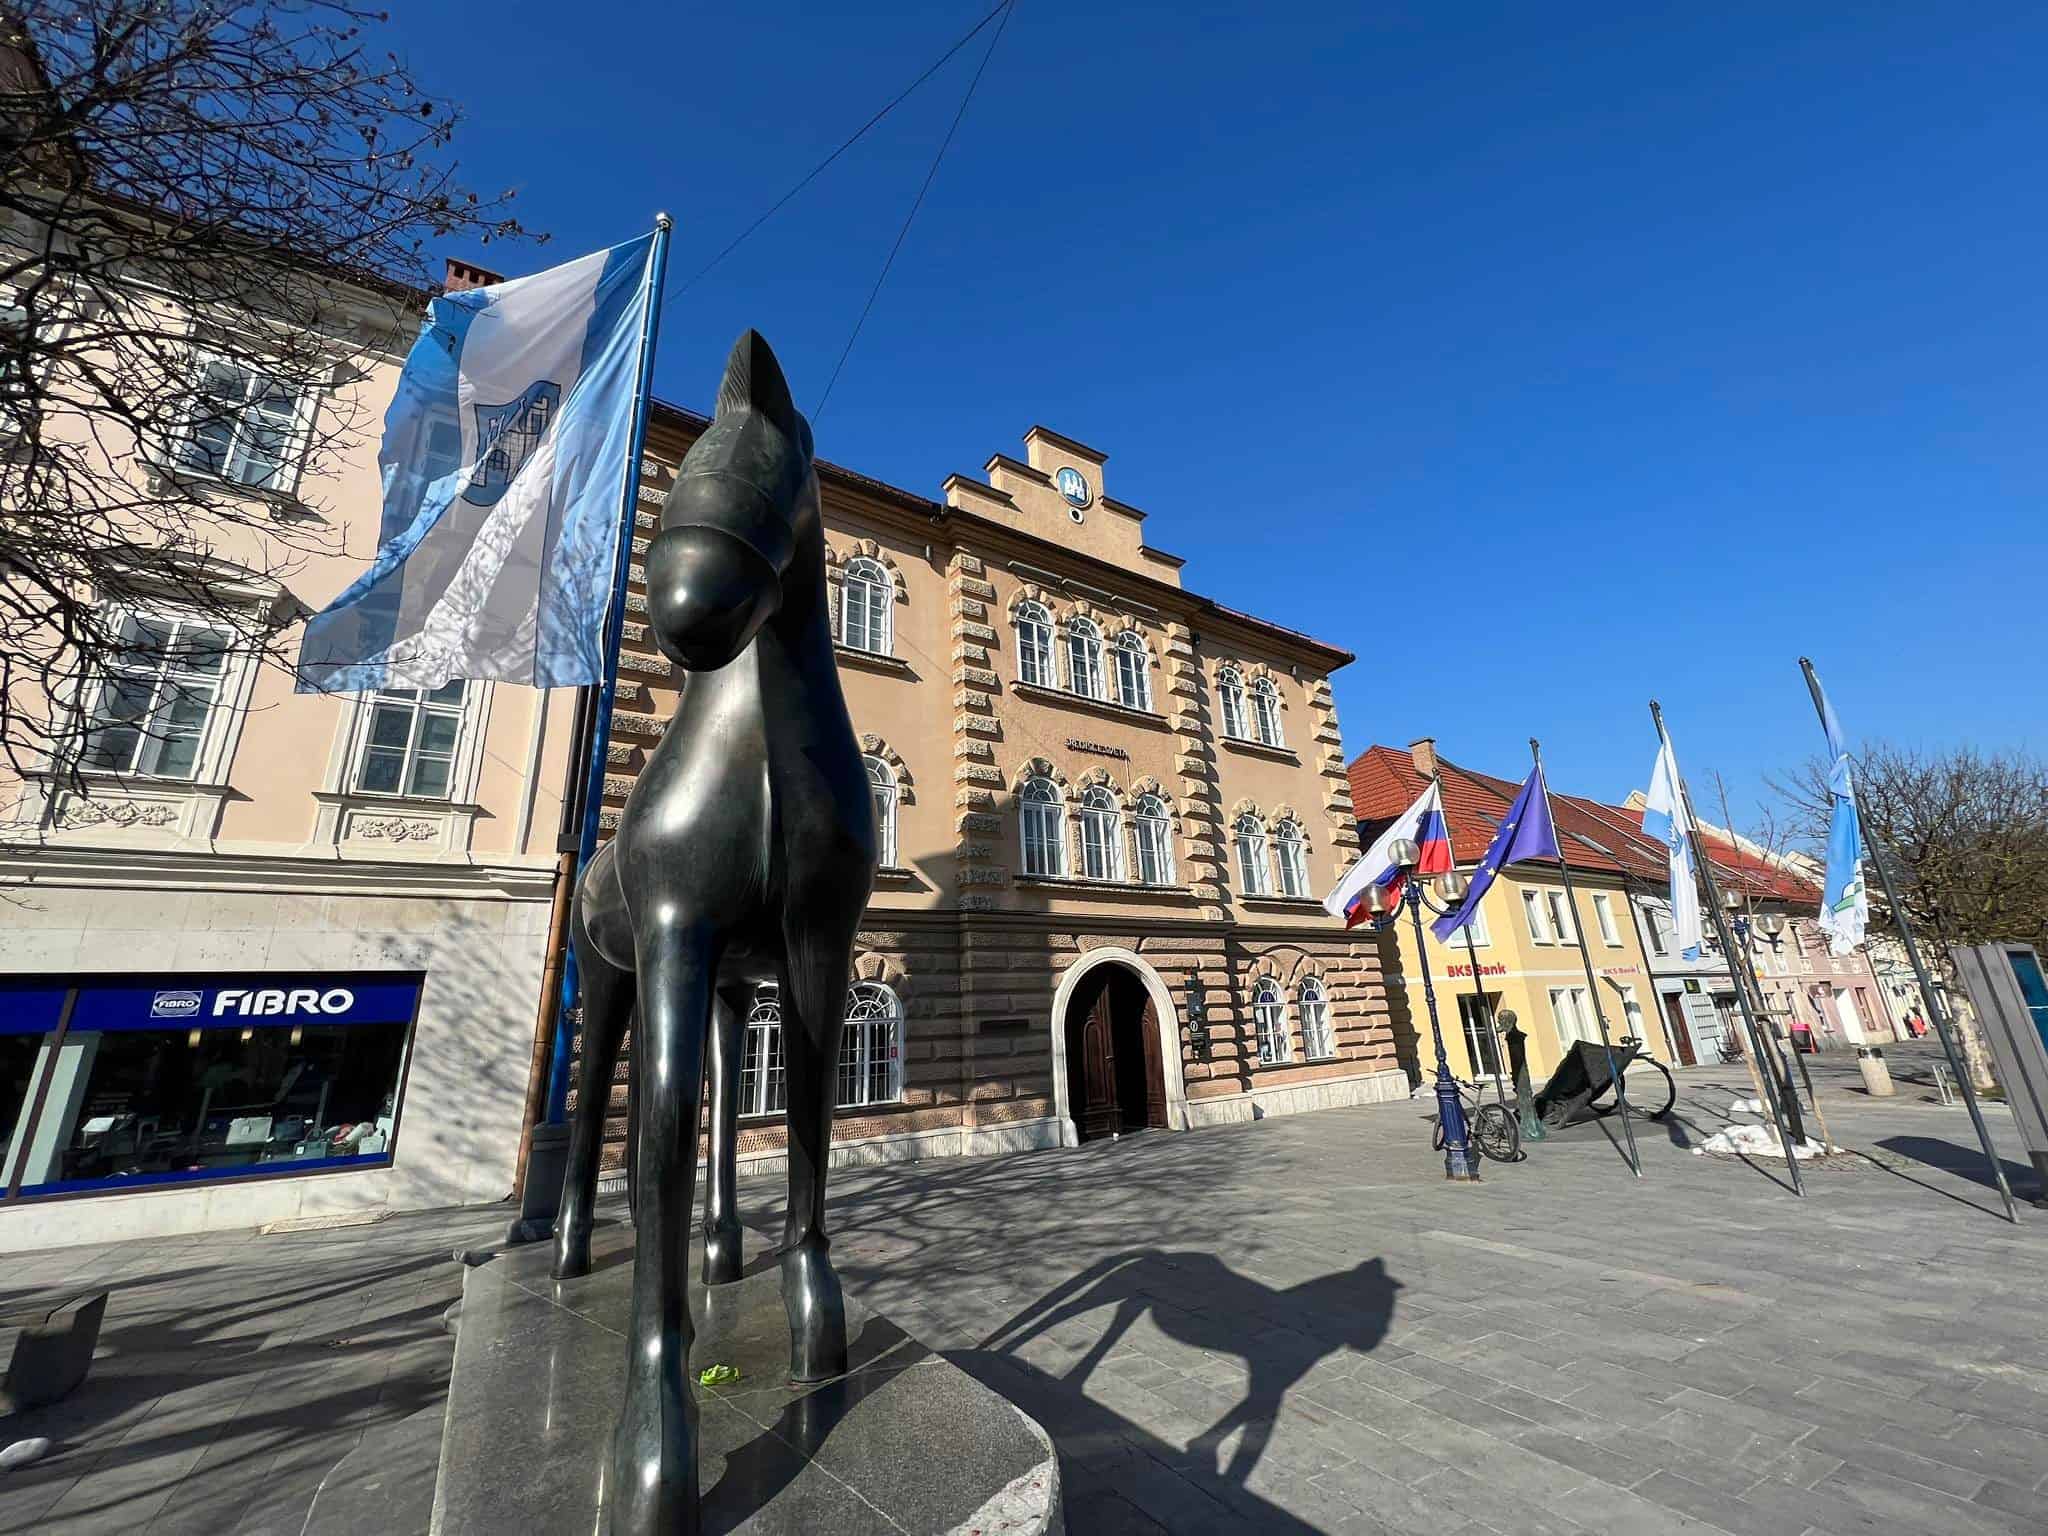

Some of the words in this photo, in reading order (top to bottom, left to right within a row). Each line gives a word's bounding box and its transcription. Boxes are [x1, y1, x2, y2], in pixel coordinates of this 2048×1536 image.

[1447, 964, 1473, 978] BKS
[1476, 962, 1506, 976] Bank
[158, 999, 195, 1009] FIBRO
[212, 988, 355, 1017] FIBRO
